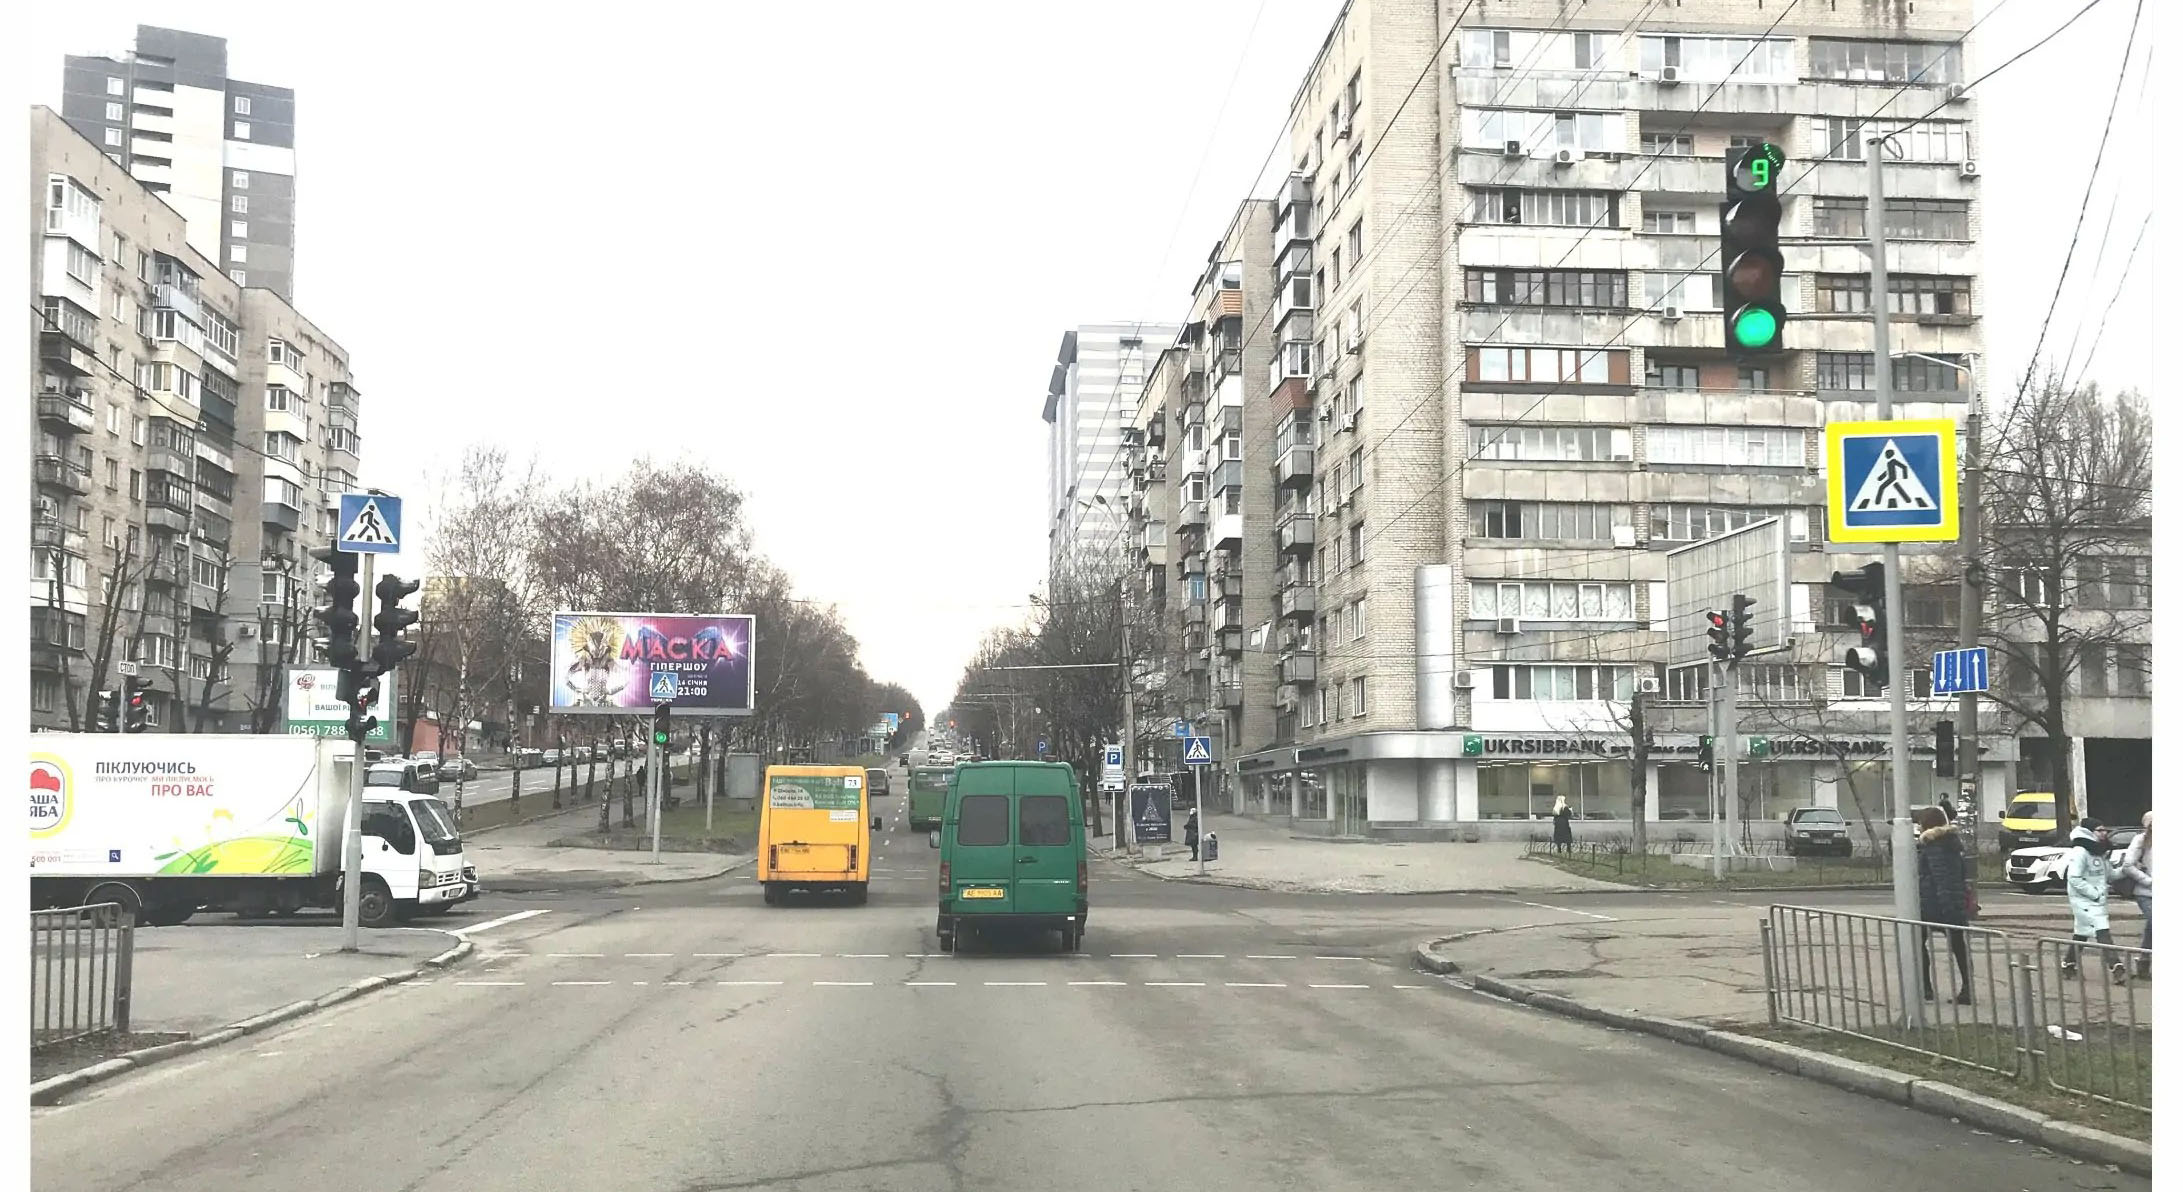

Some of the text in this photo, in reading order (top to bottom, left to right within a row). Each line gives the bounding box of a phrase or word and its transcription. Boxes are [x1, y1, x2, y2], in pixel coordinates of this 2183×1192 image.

[1752, 159, 1769, 186] 9
[620, 635, 733, 664] МАСКА
[120, 662, 135, 673] СТОП
[650, 662, 708, 671] ГІПЕРШОУ
[678, 687, 707, 696] 21:00
[288, 725, 384, 736] (056) 788--38
[1038, 741, 1046, 752] P
[1484, 739, 1606, 754] UKRSIBBANK
[1770, 740, 1887, 755] UKRSIBBANK
[1110, 753, 1118, 763] P
[96, 762, 196, 774] ПІКЛУЮЧИСЬ
[848, 779, 857, 787] 73
[151, 785, 214, 796] ПРО ВАС
